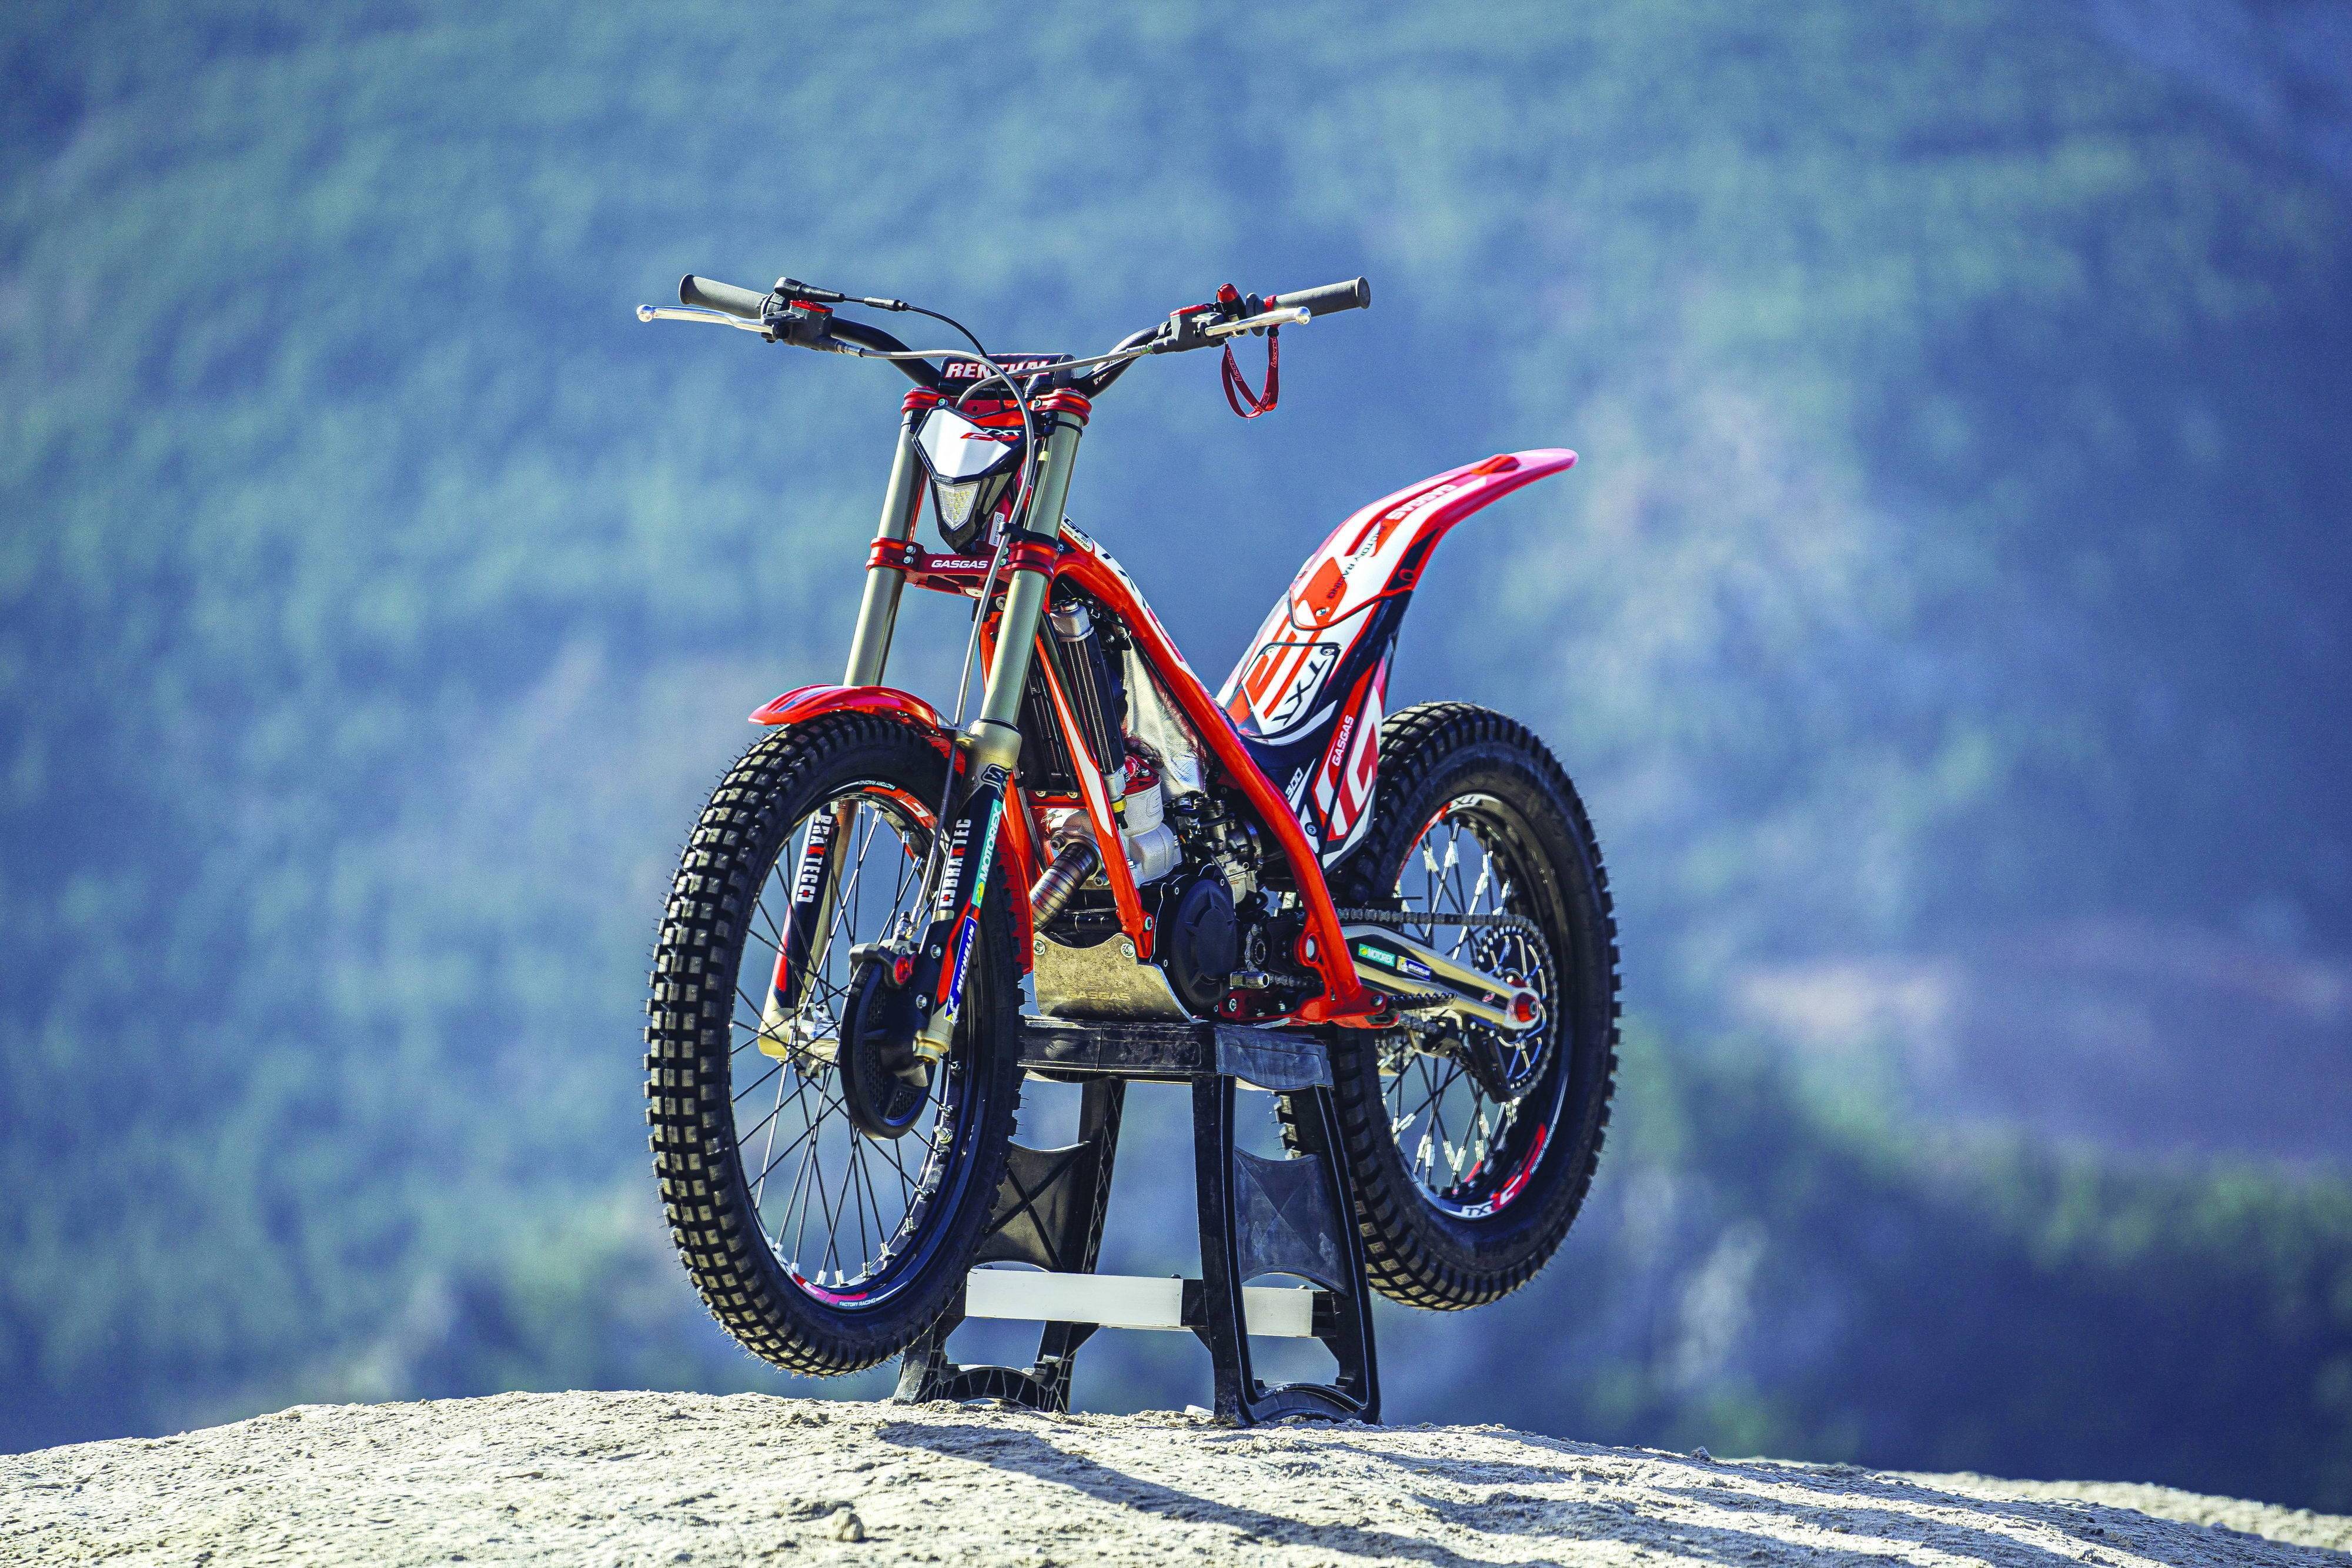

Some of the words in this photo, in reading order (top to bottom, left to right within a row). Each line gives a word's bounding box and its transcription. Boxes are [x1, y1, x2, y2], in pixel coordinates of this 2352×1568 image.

[1074, 536, 1090, 550] EDITION
[931, 560, 988, 569] GASGAS
[1271, 658, 1328, 727] TXT
[1331, 715, 1354, 766] GASGAS
[1285, 767, 1304, 800] 300
[942, 818, 971, 888] BRAKTEC
[980, 805, 1002, 882] MOTOREX
[957, 924, 975, 994] MICHELIN
[1066, 990, 1131, 1001] GASGAS
[858, 1298, 876, 1306] RACING
